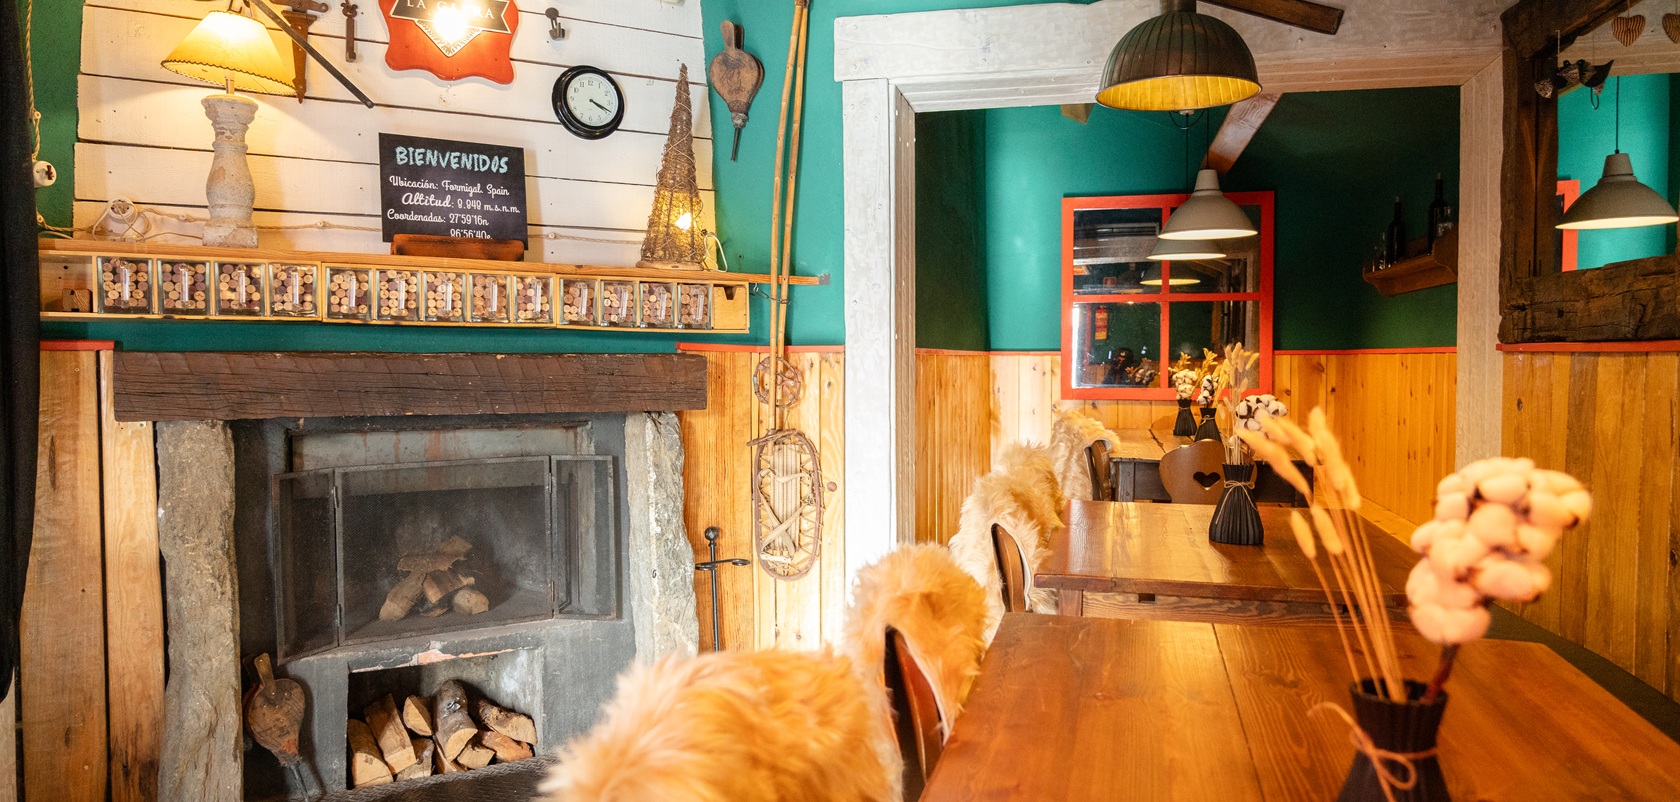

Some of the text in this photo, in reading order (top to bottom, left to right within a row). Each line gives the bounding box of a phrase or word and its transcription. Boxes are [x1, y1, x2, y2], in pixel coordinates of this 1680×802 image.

[407, 0, 495, 19] LA GLRA
[395, 146, 509, 173] BIENVENIDOS
[389, 175, 438, 190] Ubicación:
[486, 184, 510, 198] Spain
[402, 192, 521, 213] Altitud: 8.848 m.s.n.m.
[387, 208, 446, 223] Coordenadas:
